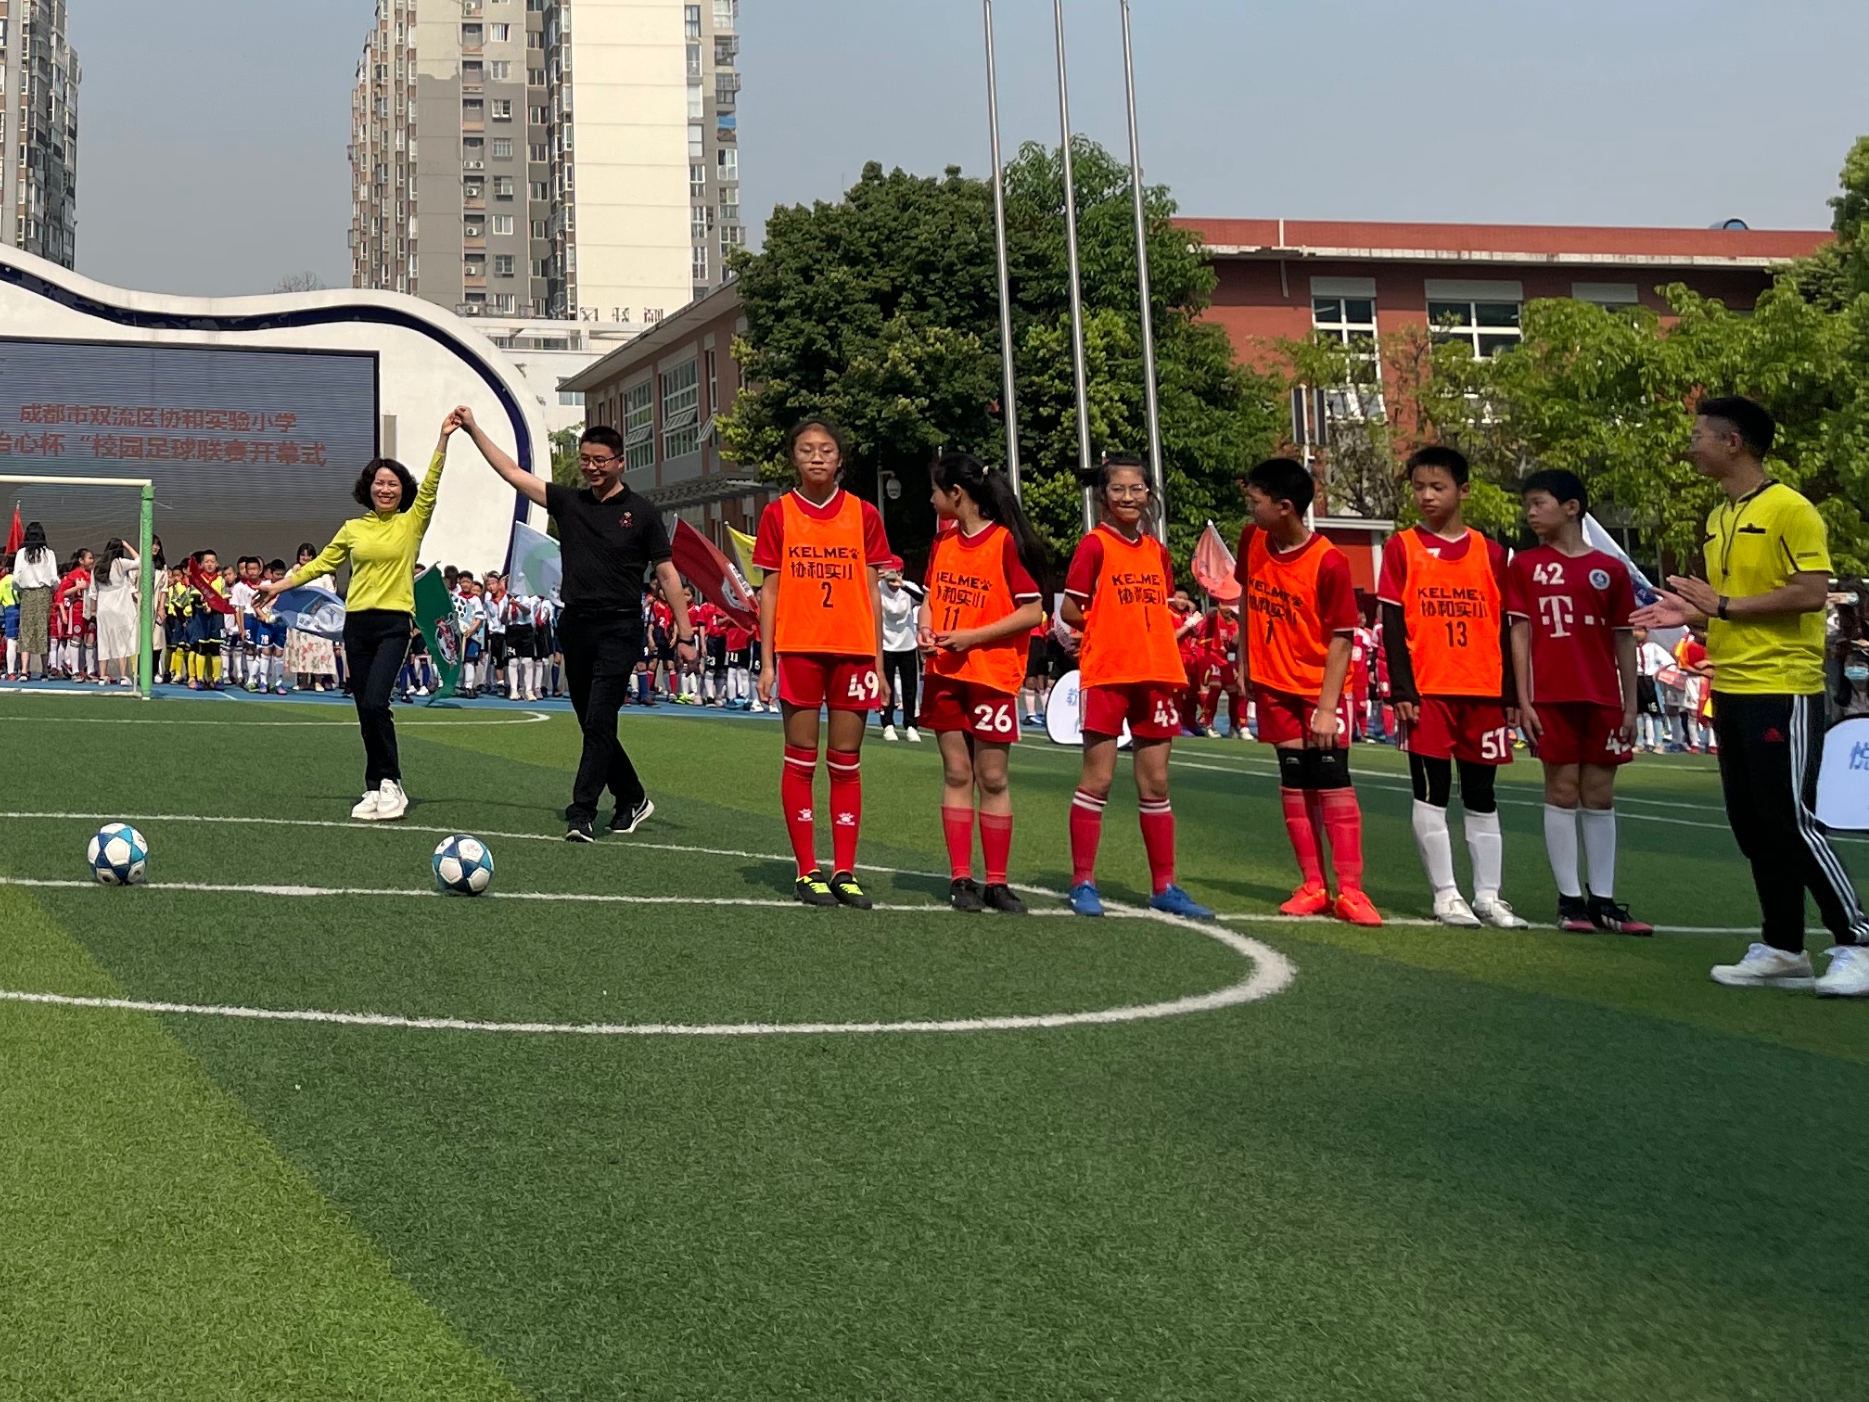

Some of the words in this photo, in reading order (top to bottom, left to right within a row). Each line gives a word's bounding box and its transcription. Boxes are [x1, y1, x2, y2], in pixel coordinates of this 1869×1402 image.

[19, 403, 297, 434] 成都市双流区协和实验小学
[788, 546, 849, 559] KELME
[1111, 573, 1161, 587] KELME
[1532, 562, 1565, 585] 42
[821, 581, 834, 609] 2
[1418, 587, 1475, 601] KELME
[942, 606, 960, 631] 11
[1445, 621, 1468, 648] 13
[848, 670, 879, 701] 49
[974, 704, 1012, 733] 26
